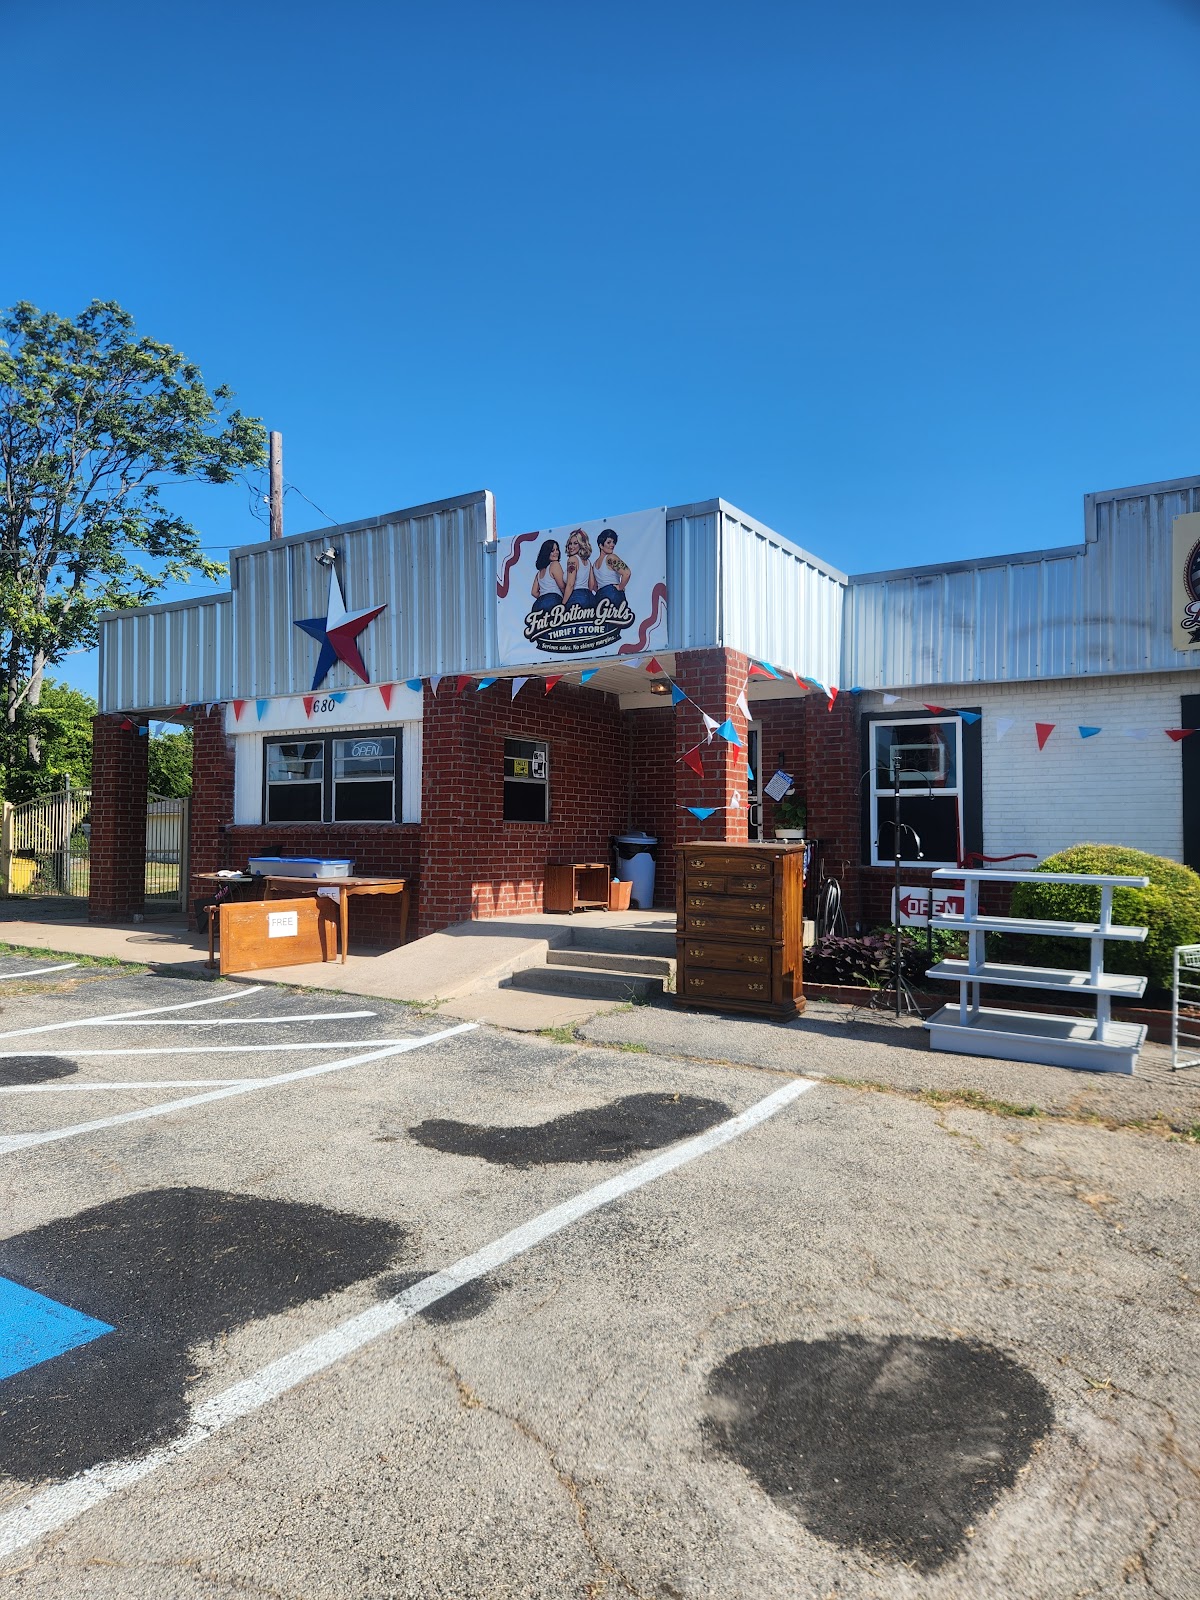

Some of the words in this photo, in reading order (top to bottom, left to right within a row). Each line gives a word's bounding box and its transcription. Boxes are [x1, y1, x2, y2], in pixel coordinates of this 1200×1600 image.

[525, 609, 551, 635] Fat
[550, 604, 595, 628] Bottom
[595, 598, 634, 625] Girls
[548, 626, 577, 639] THRIFT
[579, 625, 605, 634] STORE
[541, 642, 558, 650] Serious
[580, 641, 595, 650] skinny
[313, 698, 335, 713] 680
[352, 745, 380, 757] OPEN
[907, 899, 956, 915] OPEN
[271, 916, 293, 927] FREE
